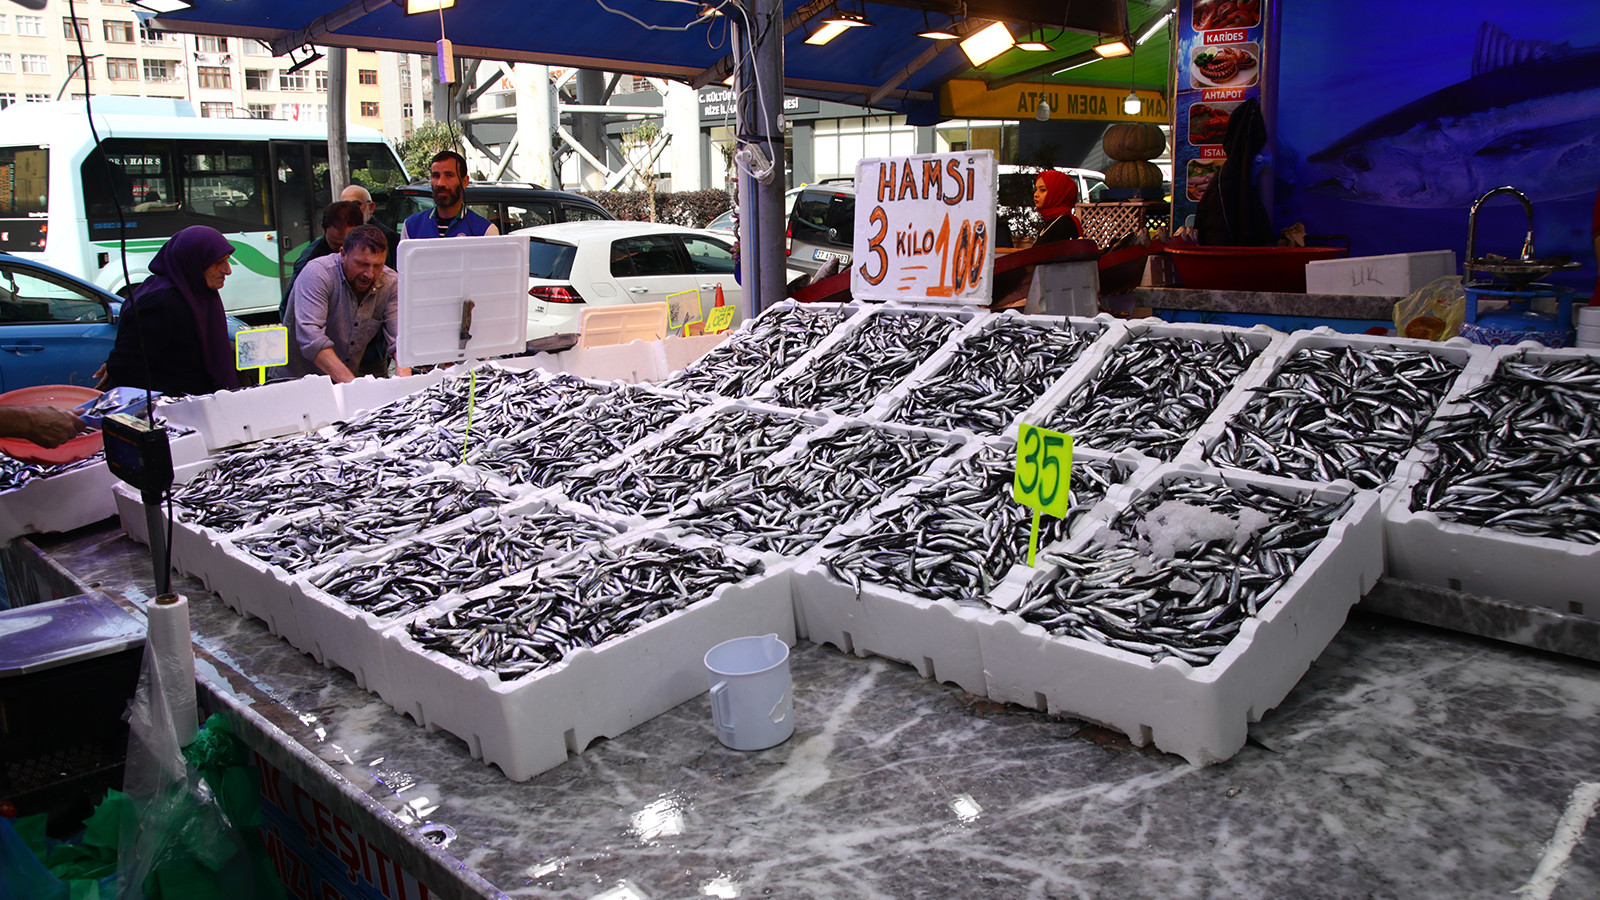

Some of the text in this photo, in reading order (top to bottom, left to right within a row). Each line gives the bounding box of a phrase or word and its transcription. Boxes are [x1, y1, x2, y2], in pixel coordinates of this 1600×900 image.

[1206, 31, 1244, 43] KARİDES
[704, 104, 720, 116] RİZE
[1204, 90, 1243, 100] AHTAPOT
[877, 157, 975, 206] HAMSİ
[859, 205, 988, 298] 3 KİLO 100
[1018, 427, 1064, 506] 35
